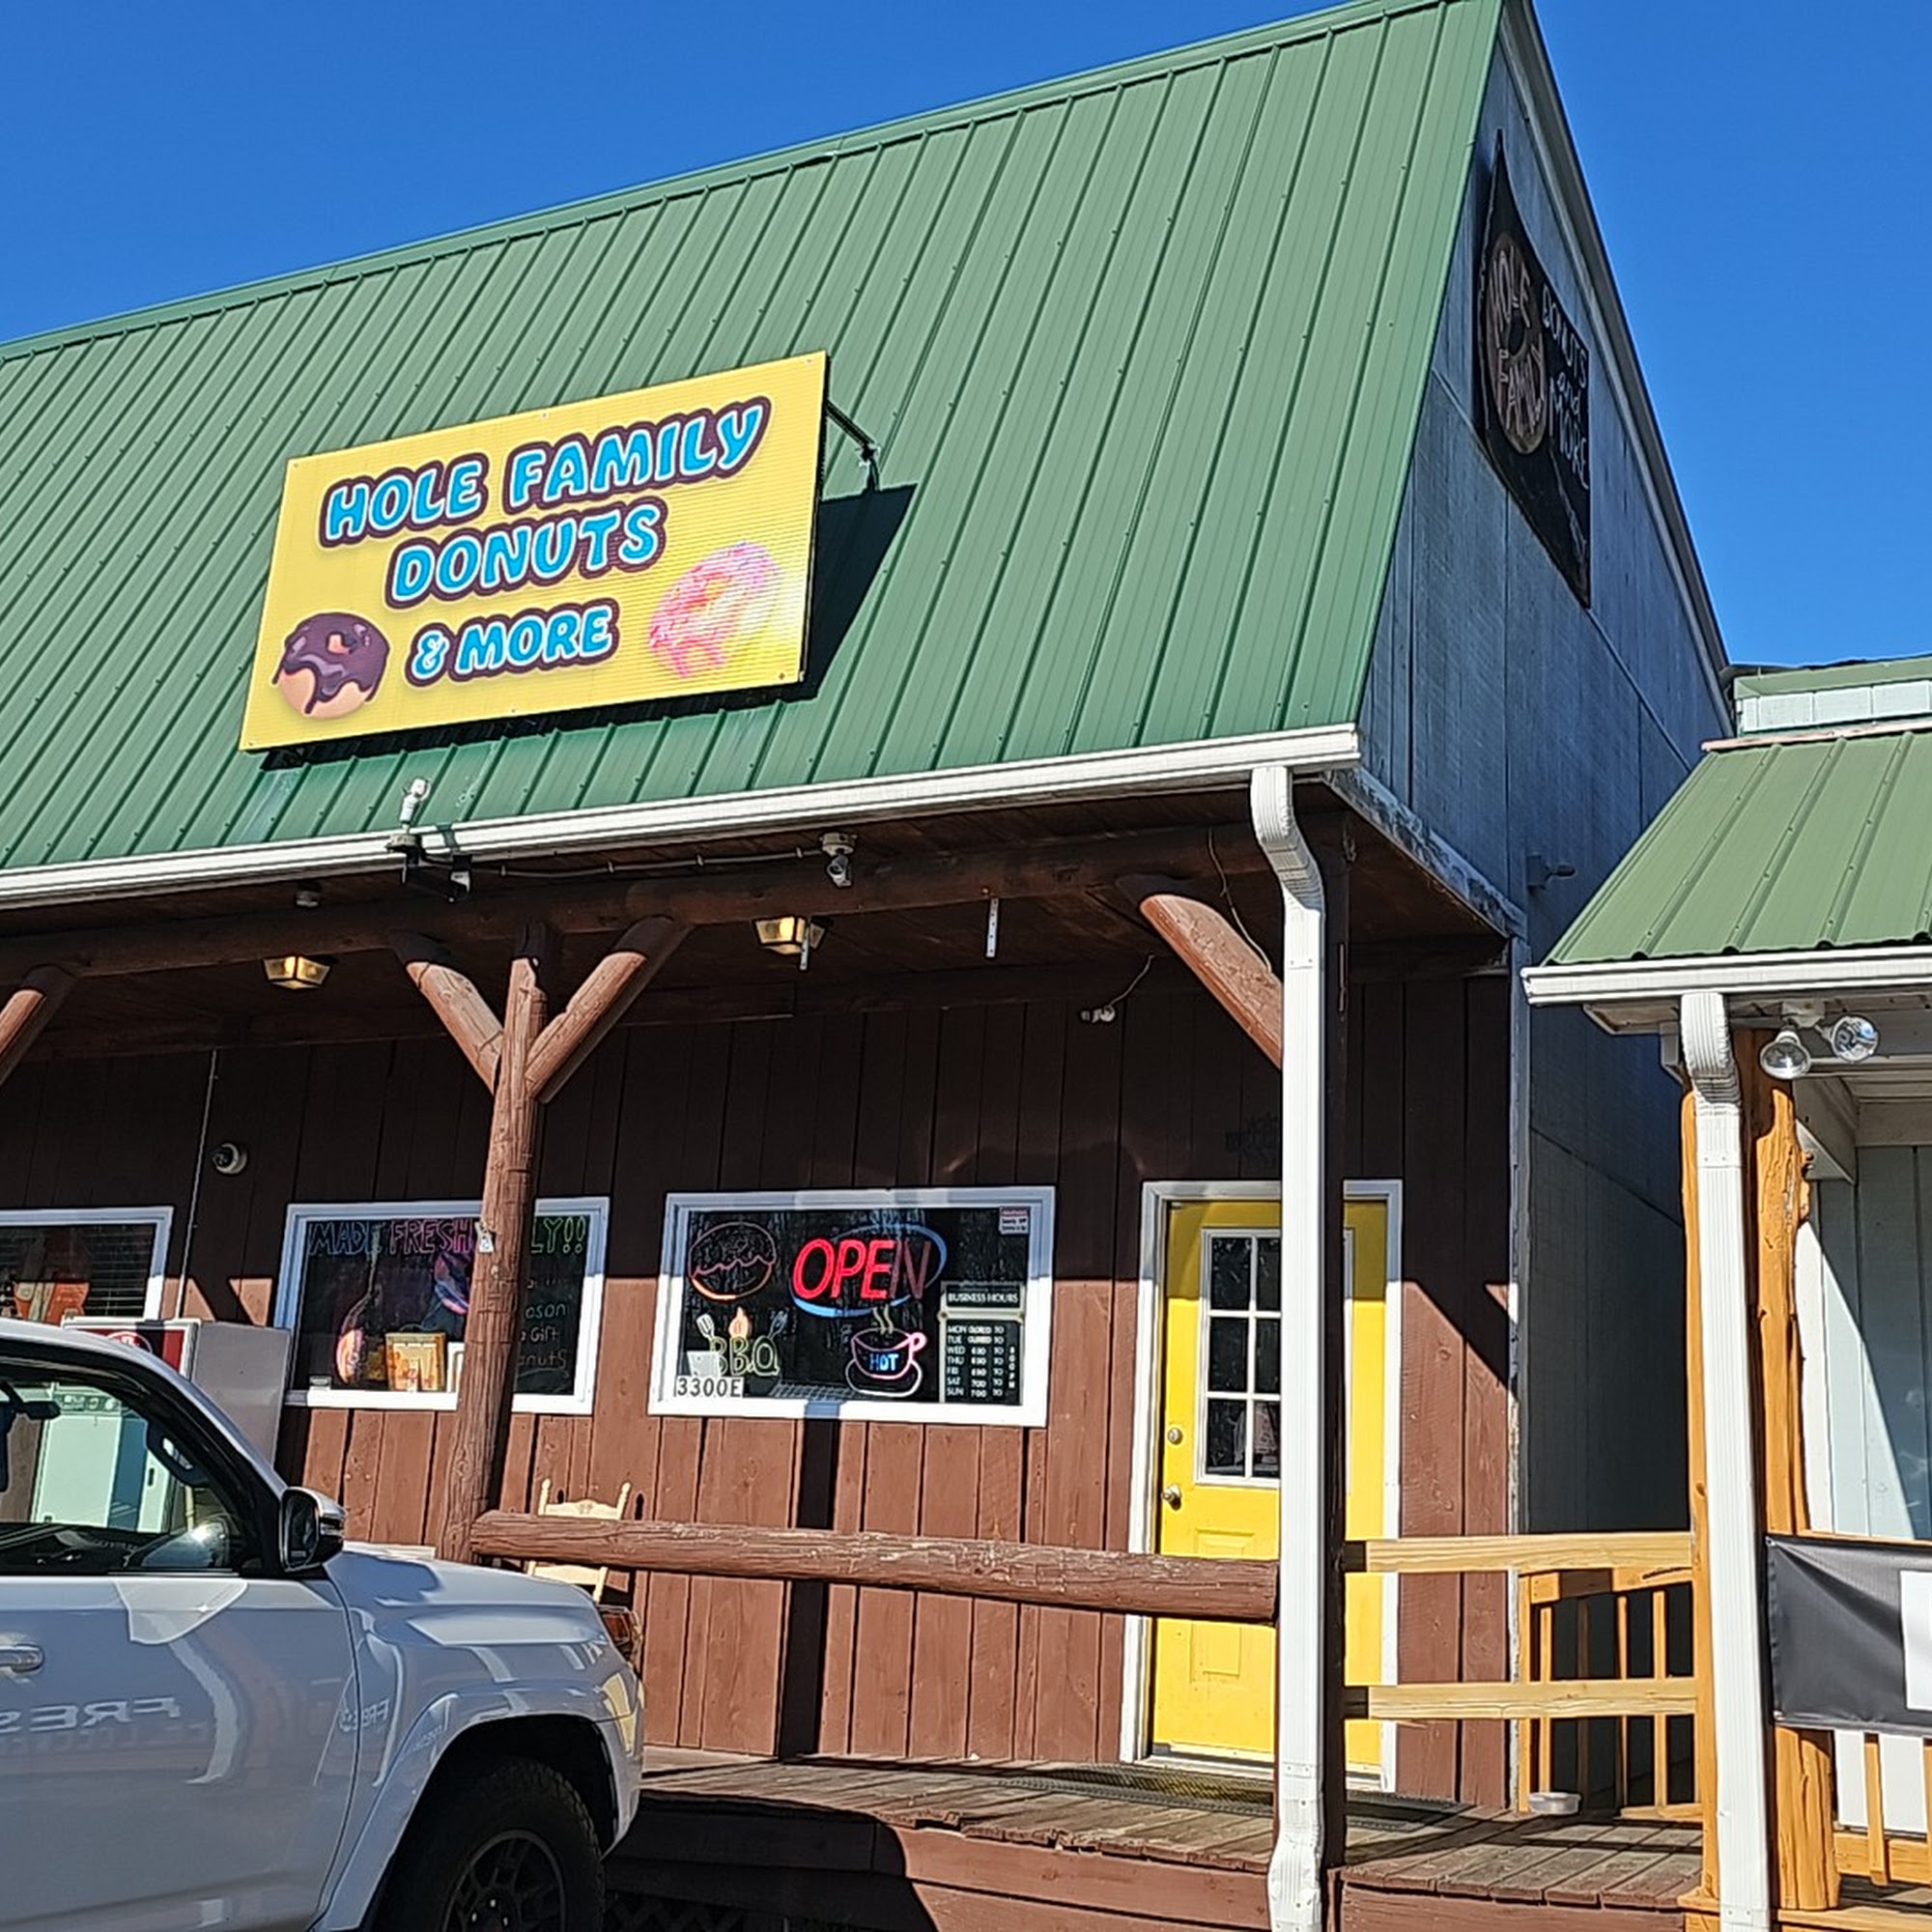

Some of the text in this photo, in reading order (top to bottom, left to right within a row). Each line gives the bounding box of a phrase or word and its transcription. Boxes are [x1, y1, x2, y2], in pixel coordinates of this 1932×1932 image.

[1549, 378, 1589, 490] MORE
[323, 400, 768, 546] HOLE FAMILY
[388, 501, 665, 606] DONUTS
[409, 605, 616, 682] & MORE
[389, 1218, 473, 1255] FRESH
[530, 1216, 586, 1254] LY!!
[792, 1237, 931, 1299] OPEN
[948, 1293, 1018, 1303] BUSINESS HOURS
[677, 1378, 741, 1397] 3300E
[869, 1352, 899, 1371] HOT
